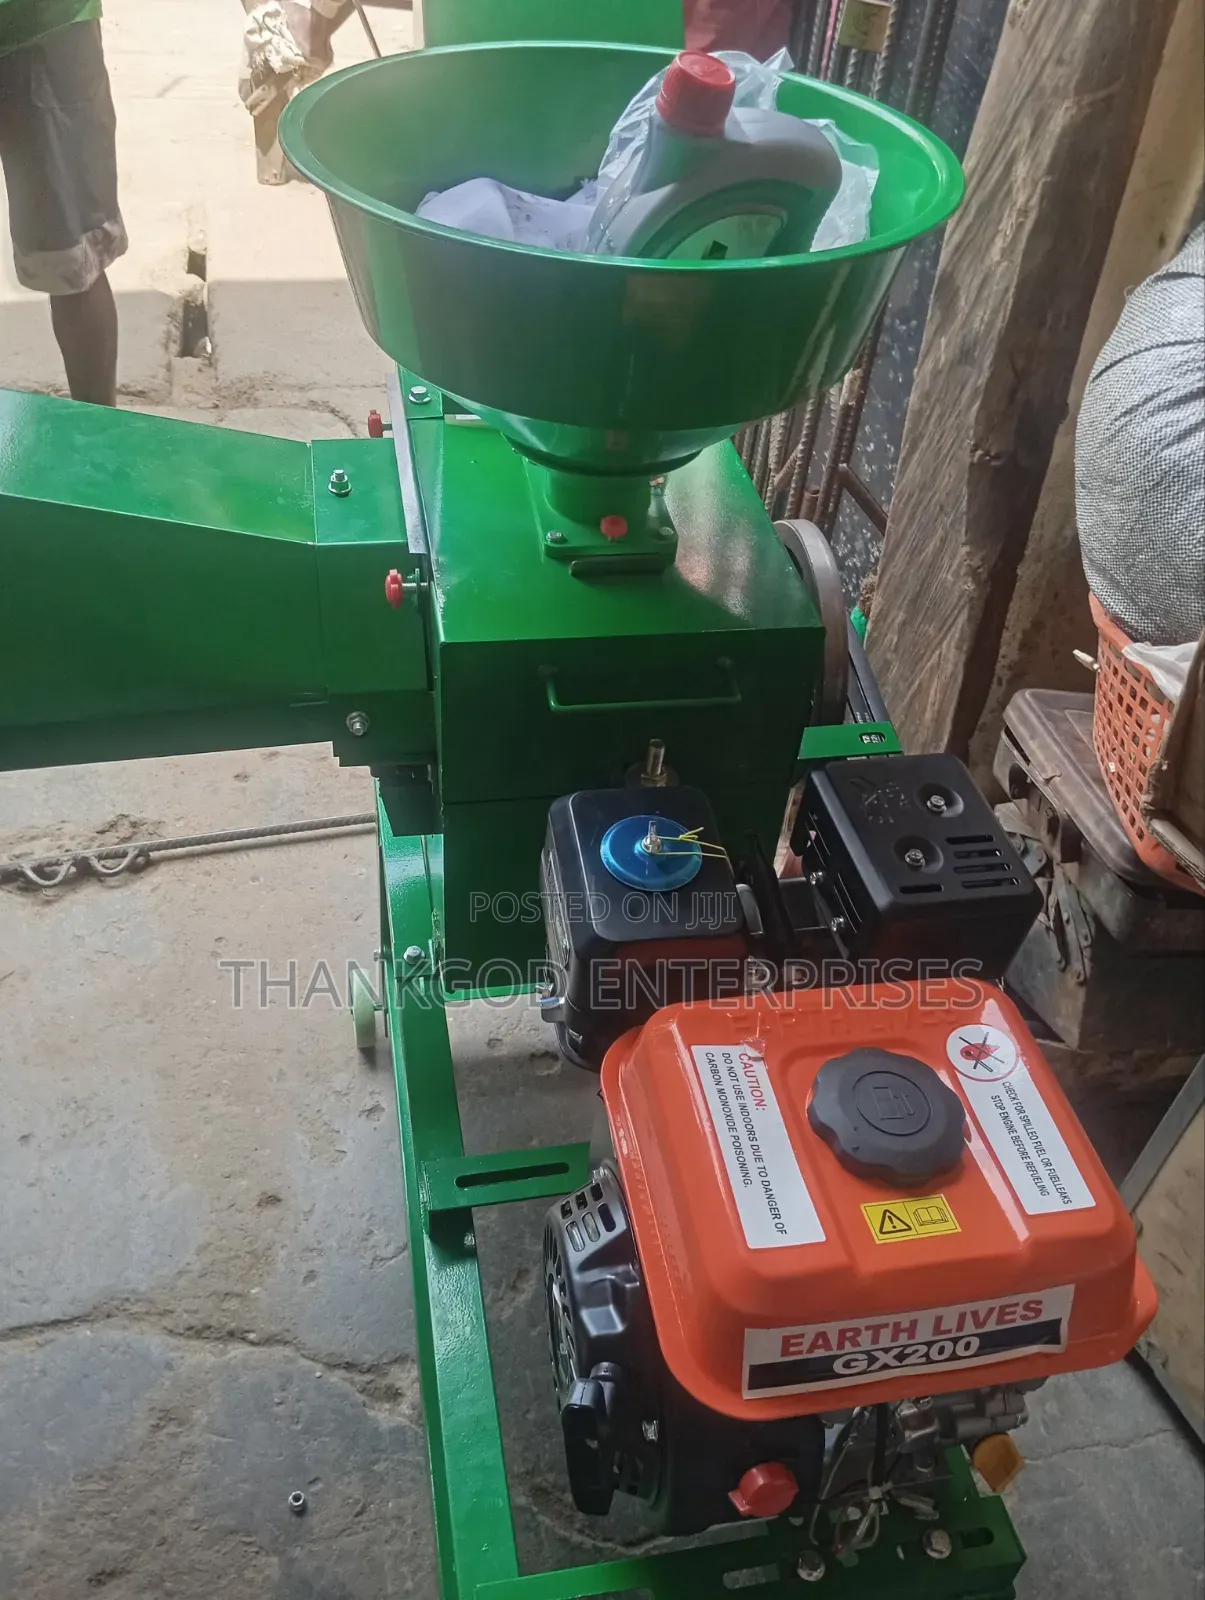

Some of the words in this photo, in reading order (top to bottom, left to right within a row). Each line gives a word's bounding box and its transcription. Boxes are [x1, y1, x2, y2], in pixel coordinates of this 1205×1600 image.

[721, 1052, 733, 1064] DO
[726, 1066, 739, 1083] NOT
[738, 1052, 768, 1111] CAUTION:
[732, 1085, 745, 1101] USE
[991, 1094, 1006, 1110] STOP
[705, 1052, 722, 1086] CARBON
[716, 1087, 738, 1133] MONOXIDE
[730, 1135, 753, 1188] POISONING.
[738, 1102, 758, 1142] INDOORS
[998, 1110, 1018, 1136] ENGINE
[1002, 1081, 1020, 1102] CHECK
[1014, 1101, 1026, 1115] FOR
[1032, 1140, 1047, 1158] FUEL
[1040, 1157, 1053, 1168] OR
[750, 1144, 764, 1163] DUE
[1010, 1134, 1031, 1162] BEFORE
[757, 1165, 768, 1178] TO
[1024, 1161, 1050, 1197] REFUELING
[761, 1180, 782, 1220] DANGER
[774, 1222, 788, 1235] OF
[780, 1318, 919, 1358] EARTH
[931, 1299, 1044, 1336] LIVES
[832, 1335, 981, 1375] GX200
